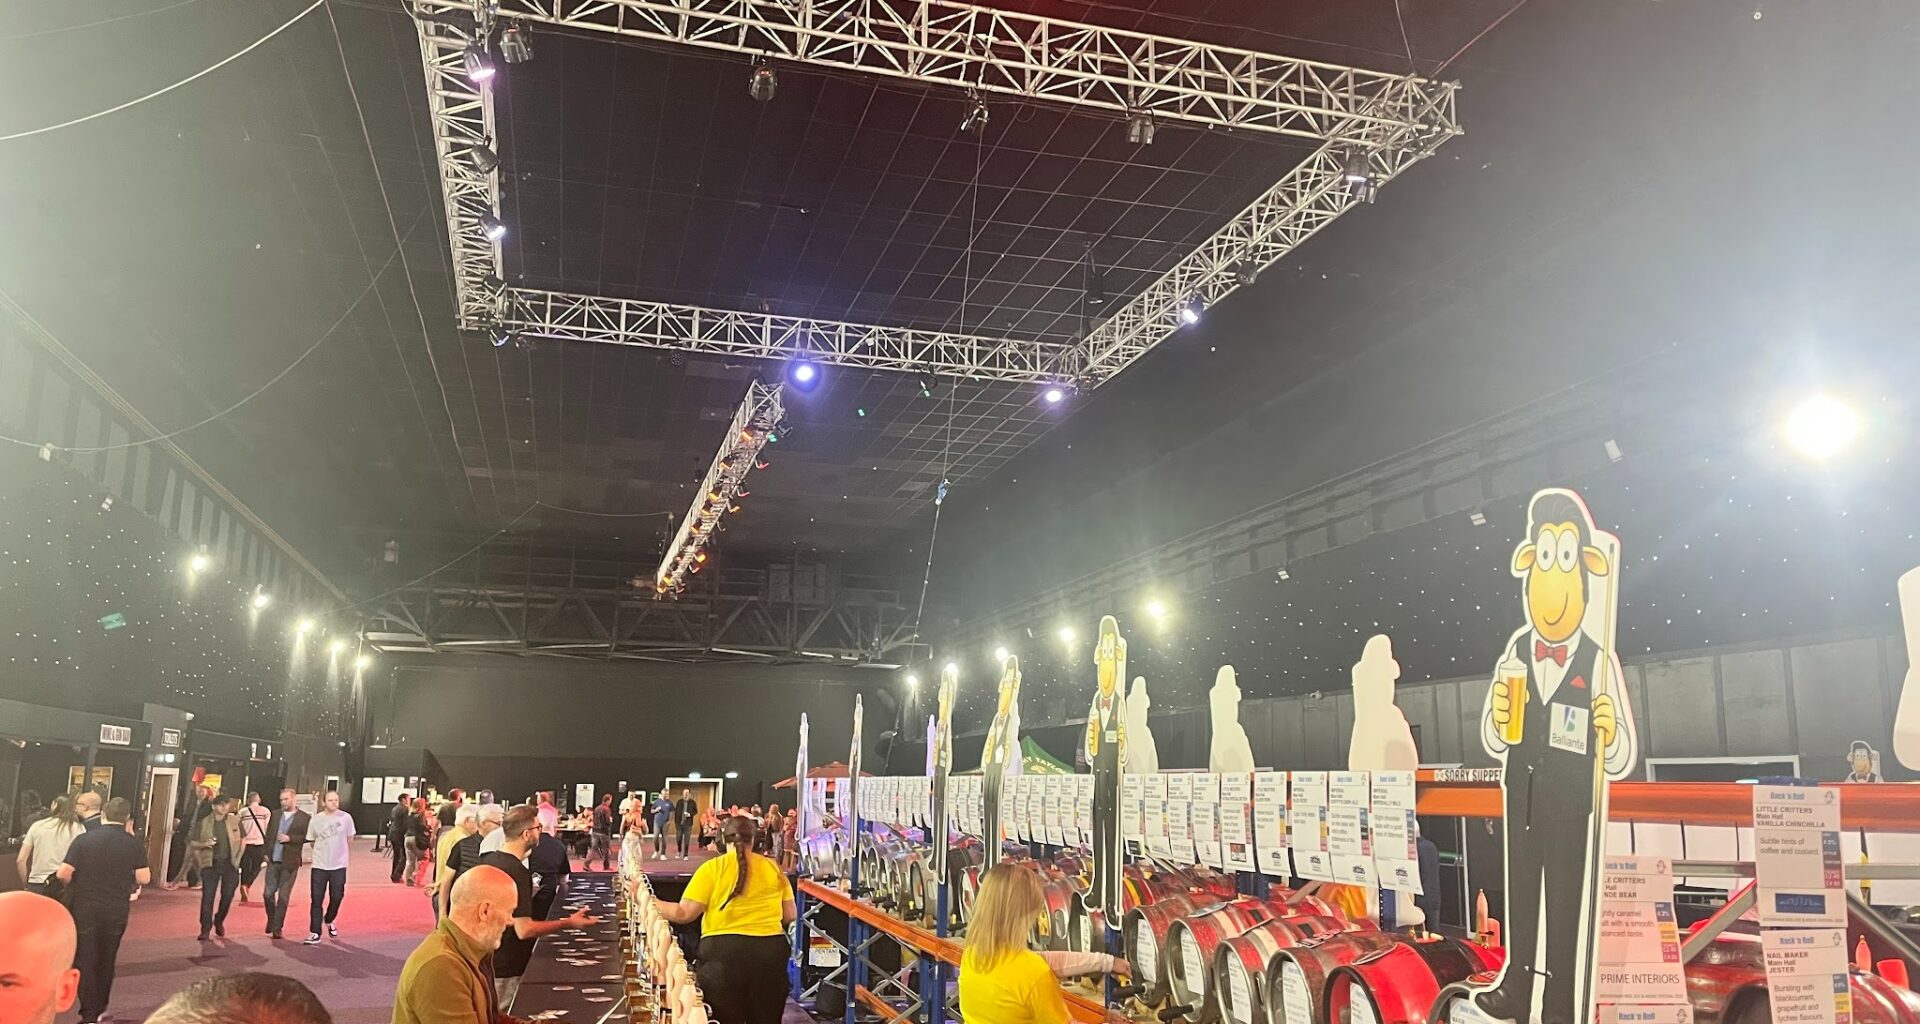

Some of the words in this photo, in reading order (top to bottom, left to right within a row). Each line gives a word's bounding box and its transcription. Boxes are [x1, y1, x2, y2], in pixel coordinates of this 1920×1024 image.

[1551, 732, 1585, 750] Balliante
[1444, 769, 1470, 782] SORRY
[1473, 769, 1502, 781] SUPPE
[1600, 973, 1630, 984] PRIME
[1632, 973, 1680, 984] INTERIORS
[1774, 984, 1800, 993] Bursting
[1776, 1004, 1806, 1012] grapefruit
